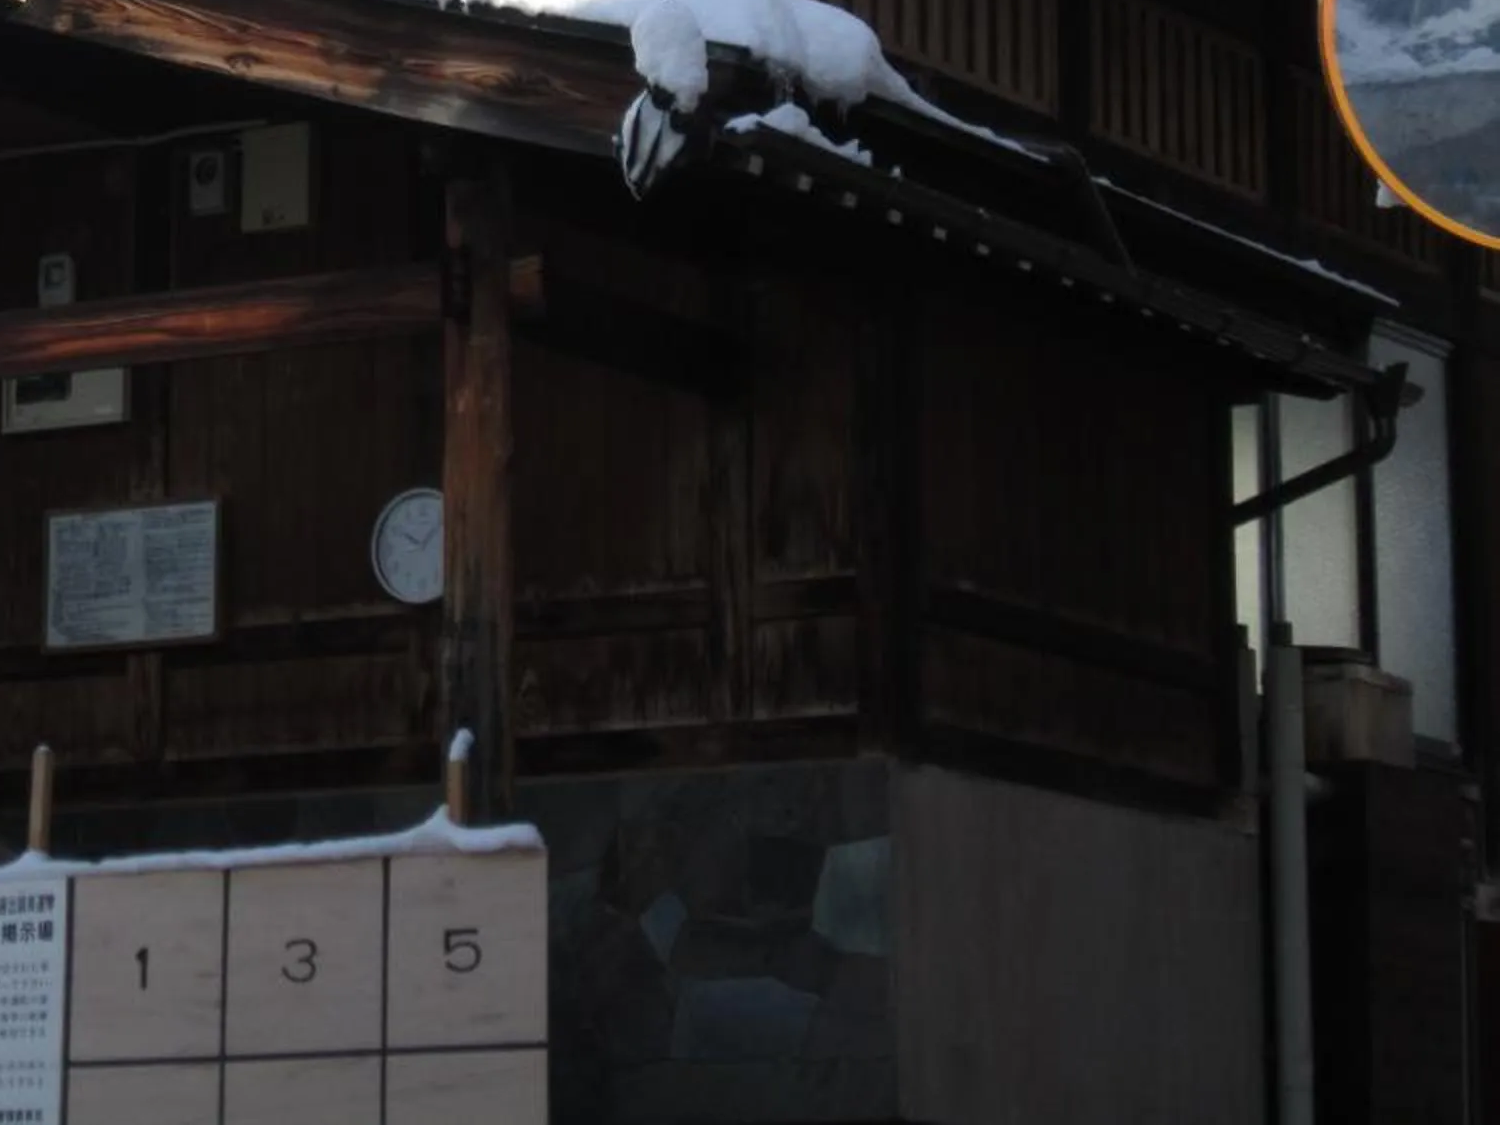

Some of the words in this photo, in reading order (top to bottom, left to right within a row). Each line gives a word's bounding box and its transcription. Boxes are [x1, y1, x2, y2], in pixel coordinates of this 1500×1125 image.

[135, 947, 148, 991] 1
[280, 938, 318, 983] 3
[443, 928, 482, 973] 5
